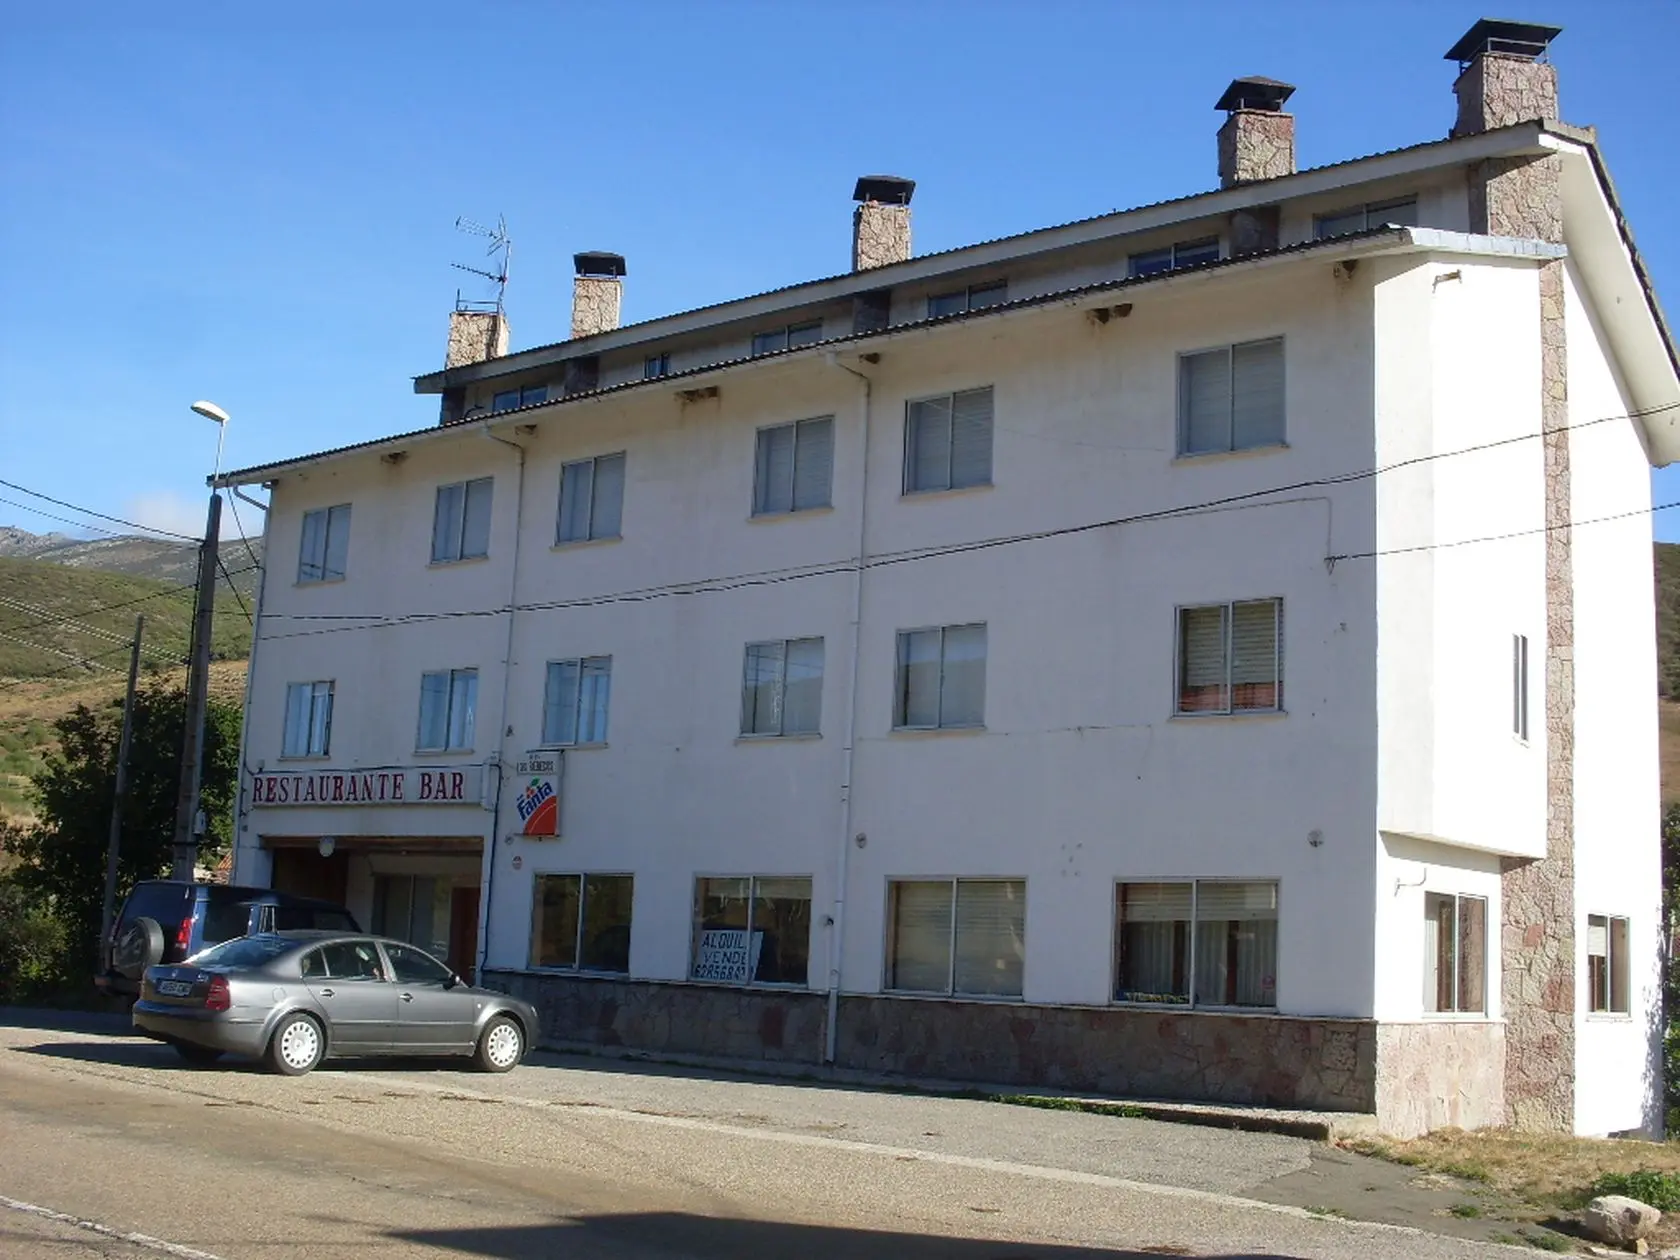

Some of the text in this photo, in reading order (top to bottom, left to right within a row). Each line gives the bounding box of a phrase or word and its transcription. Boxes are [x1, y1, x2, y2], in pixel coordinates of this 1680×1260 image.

[252, 772, 464, 803] RESTAURANTE BAR
[516, 781, 553, 821] Fanta
[702, 932, 748, 950] ALQUIL
